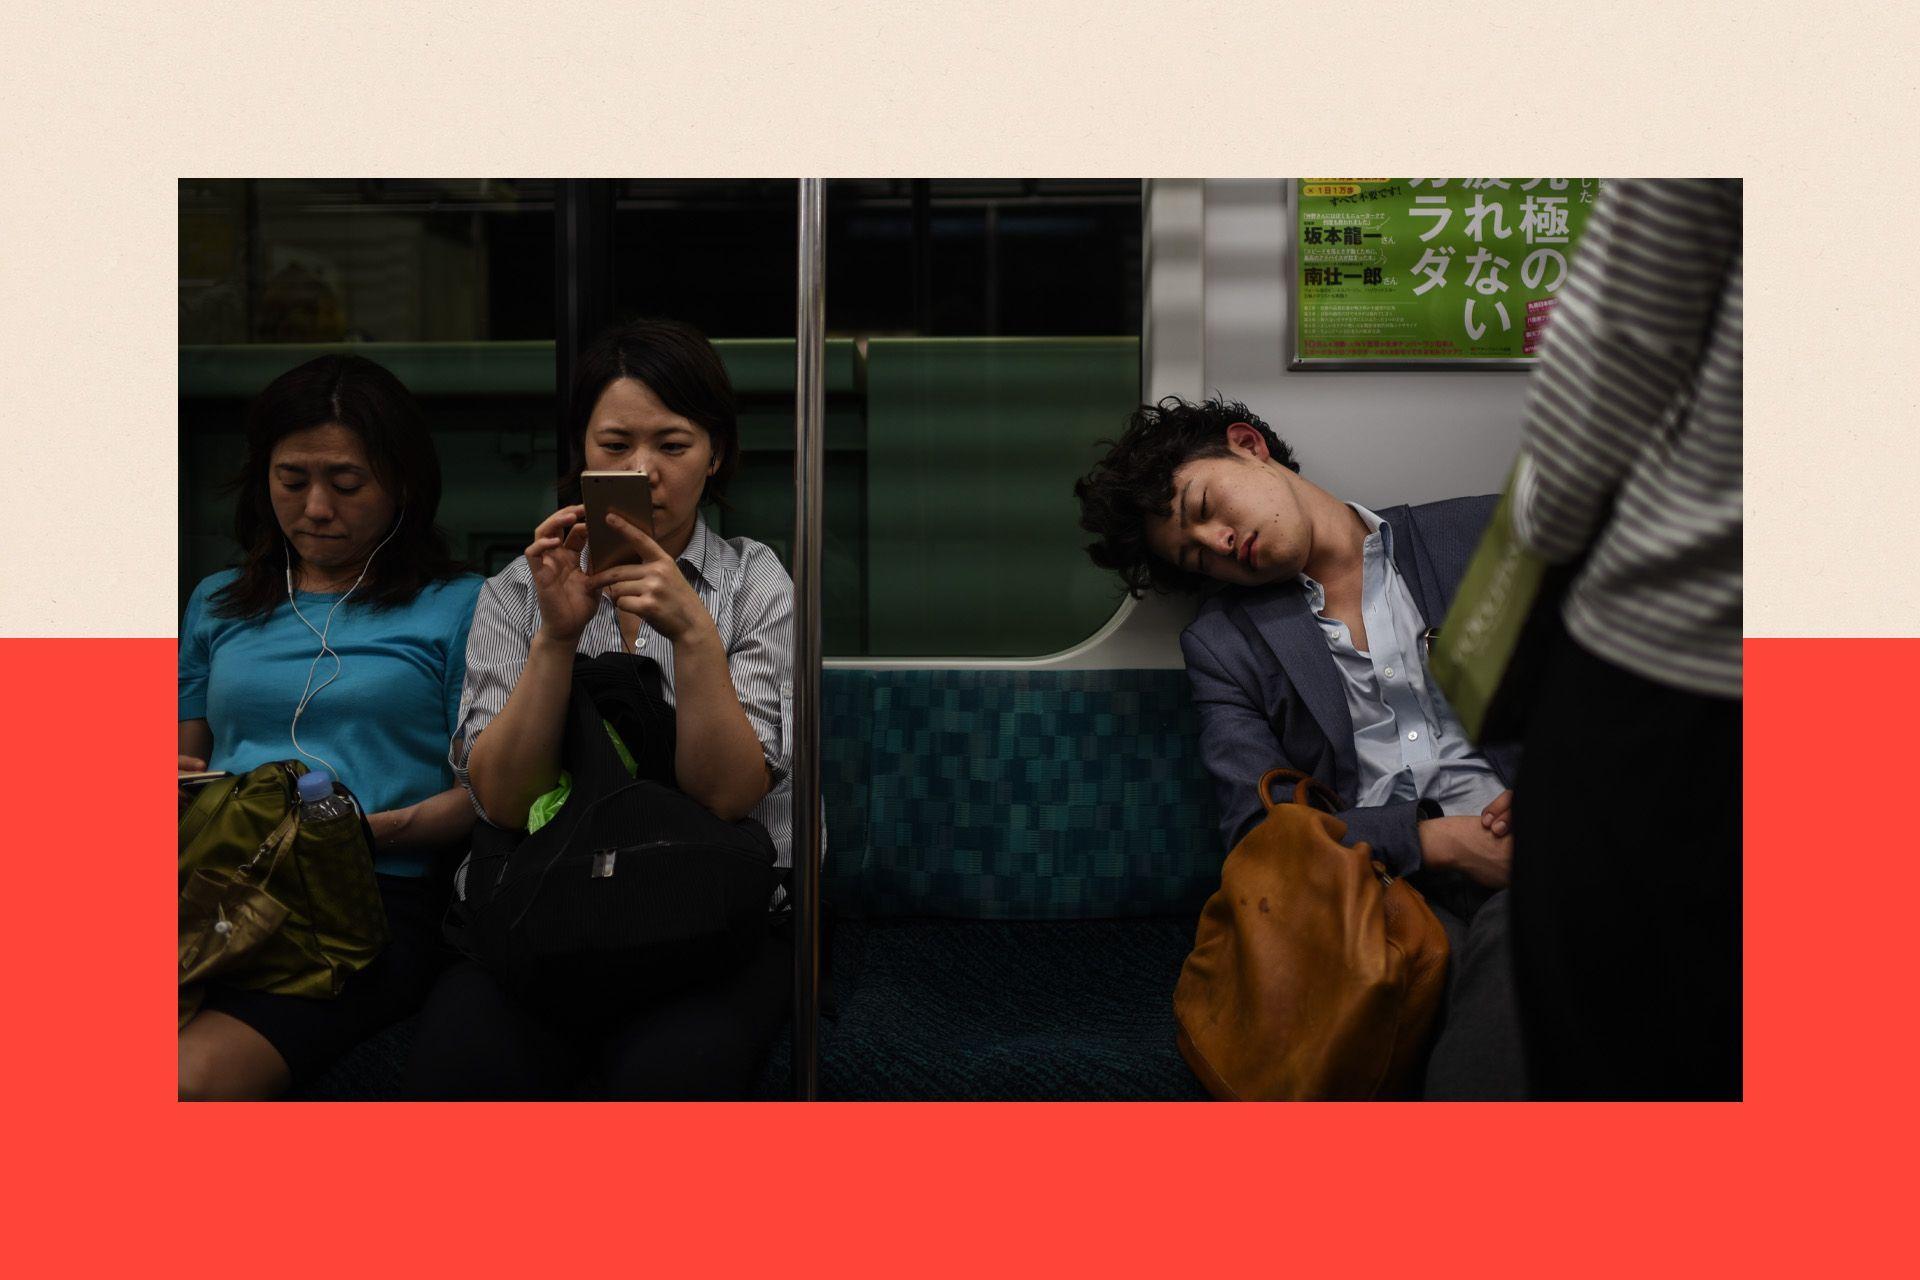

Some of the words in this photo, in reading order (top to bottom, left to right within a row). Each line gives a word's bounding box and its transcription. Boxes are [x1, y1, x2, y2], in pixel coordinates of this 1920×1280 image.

[1408, 178, 1456, 296] ラダ
[1462, 178, 1513, 341] れない
[1519, 178, 1569, 293] 極の
